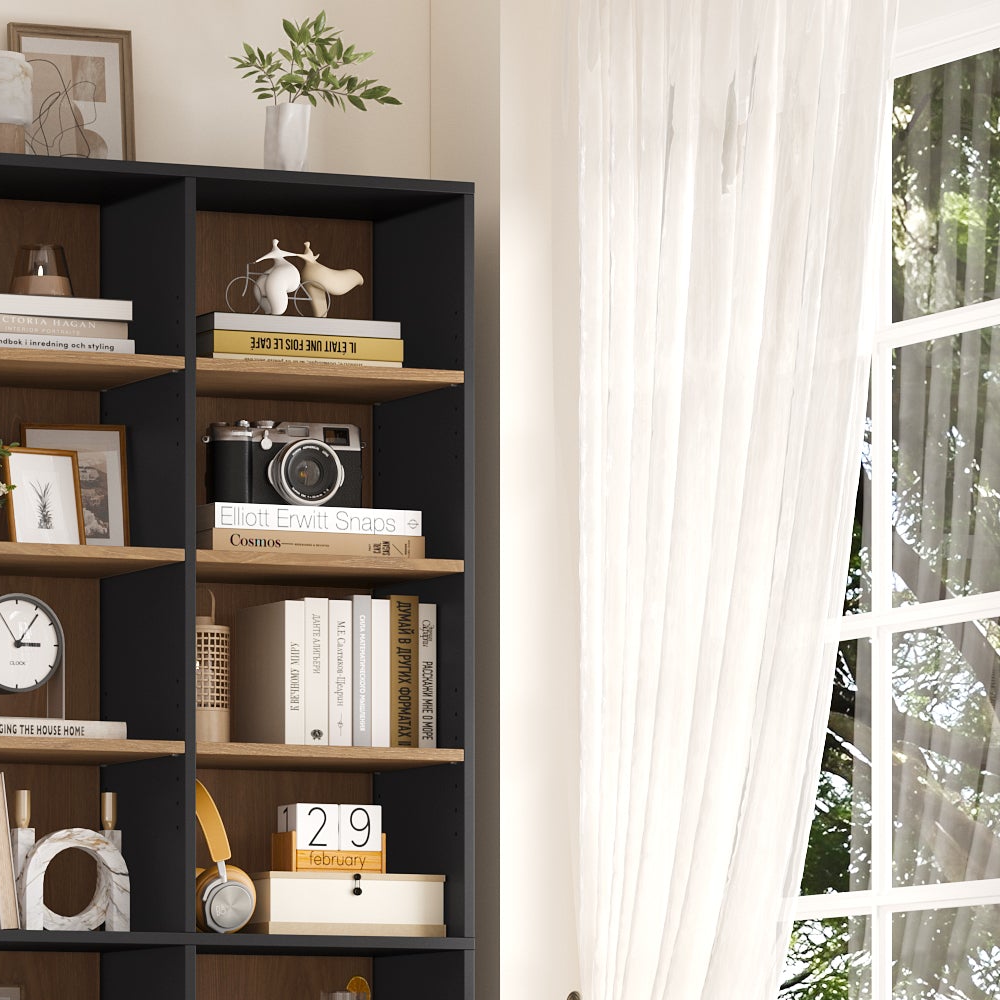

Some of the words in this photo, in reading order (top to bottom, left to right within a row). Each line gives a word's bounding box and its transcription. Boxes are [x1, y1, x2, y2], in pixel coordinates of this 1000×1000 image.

[53, 319, 96, 329] HAGAN
[29, 339, 69, 349] inredning
[71, 341, 86, 349] och
[87, 342, 115, 352] styling
[273, 338, 283, 350] LE
[285, 338, 304, 351] FOIS
[306, 340, 322, 352] UNE
[220, 505, 270, 527] Elliott
[277, 508, 329, 530] Erwitt
[335, 511, 396, 535] Snaps
[230, 533, 281, 548] Cosmos
[396, 600, 414, 635] ДУМАЙ
[396, 646, 412, 684] ДРУГИХ
[421, 661, 434, 697] РАССКАЖИ
[396, 687, 412, 737] ФОРМАТАХ
[421, 698, 434, 714] МНЕ
[19, 725, 35, 735] THE
[36, 725, 62, 736] HOUSE
[63, 726, 85, 737] HOME
[421, 721, 434, 741] МОРЕ
[309, 851, 366, 870] february
